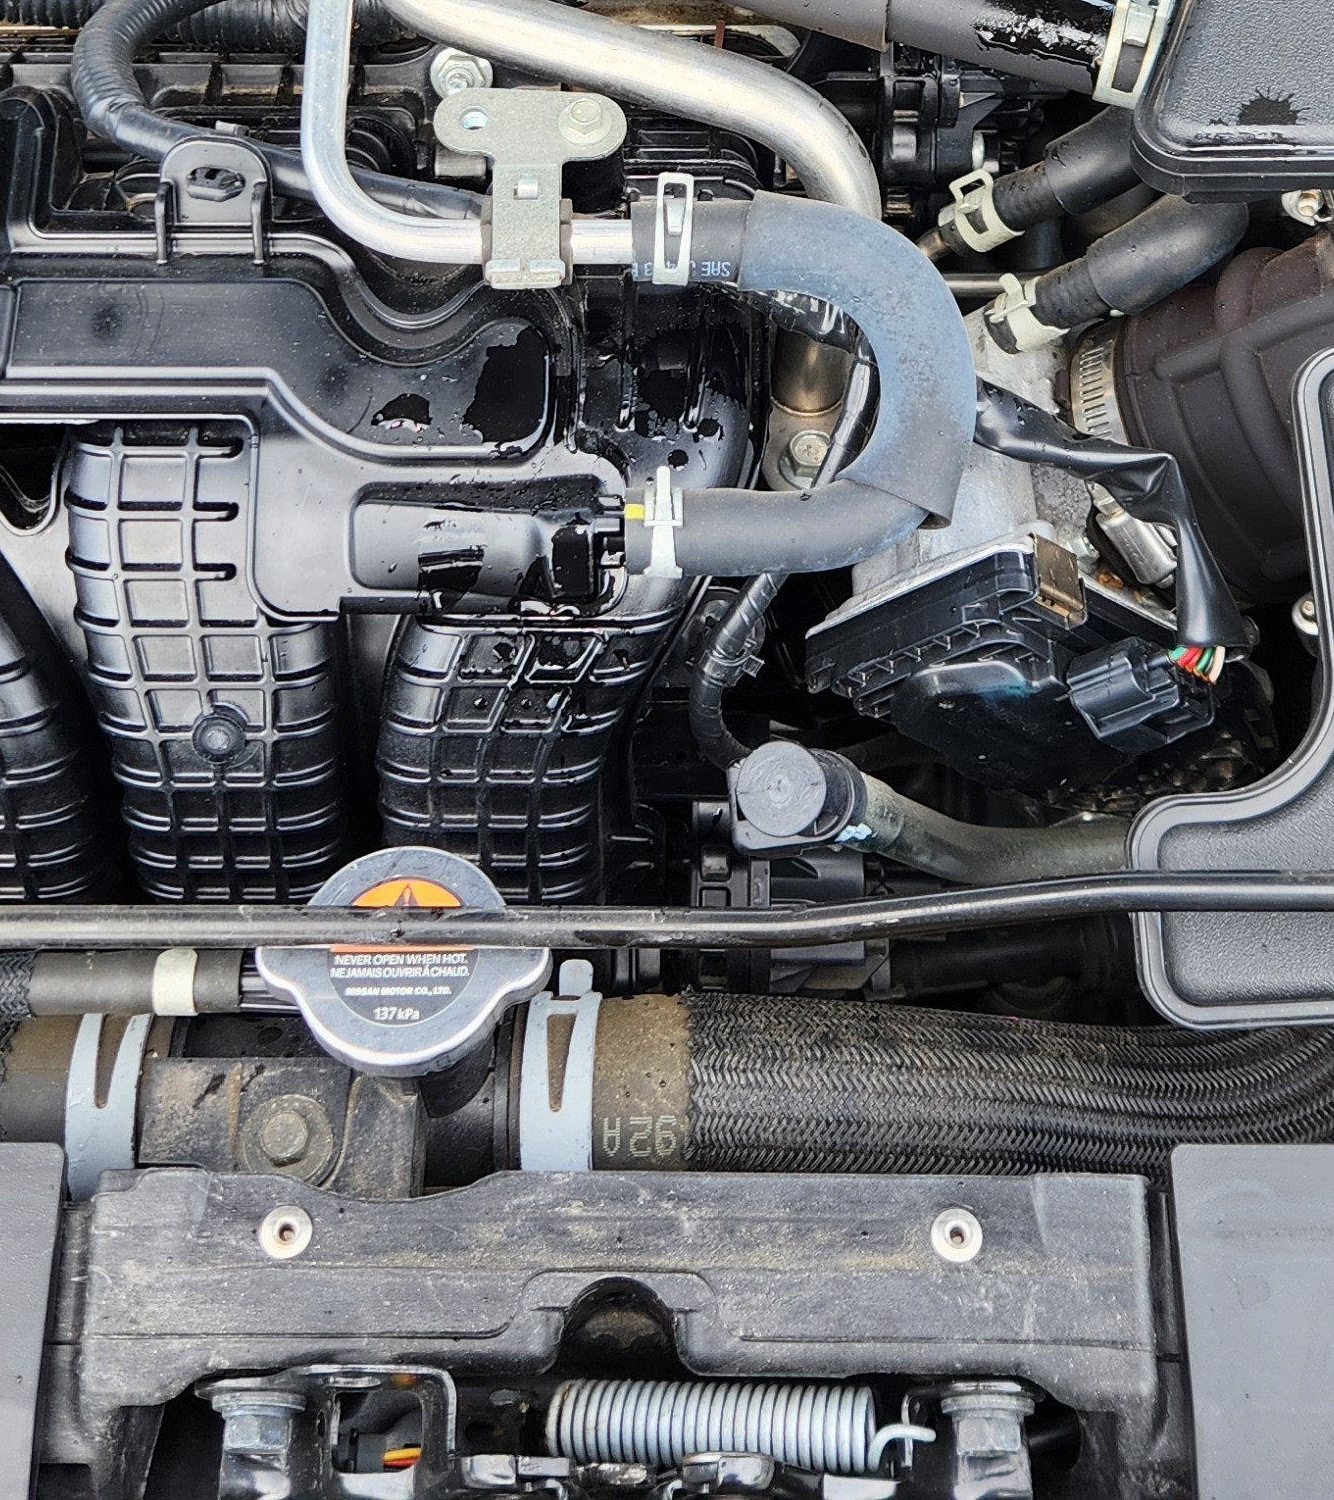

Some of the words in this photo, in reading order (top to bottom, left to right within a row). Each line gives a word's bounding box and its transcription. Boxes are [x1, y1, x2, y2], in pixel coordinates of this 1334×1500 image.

[701, 260, 731, 277] SAE
[334, 954, 371, 966] NEVER
[373, 953, 404, 966] OPEN
[406, 953, 441, 965] WHEN
[442, 953, 469, 964] HOT.
[330, 967, 346, 978] NE
[346, 967, 382, 978] JAMAIS
[383, 967, 421, 978] OUVRIR
[430, 966, 471, 978] CHAUD.
[345, 986, 380, 996] NISSAN
[380, 986, 413, 996] MOTOR
